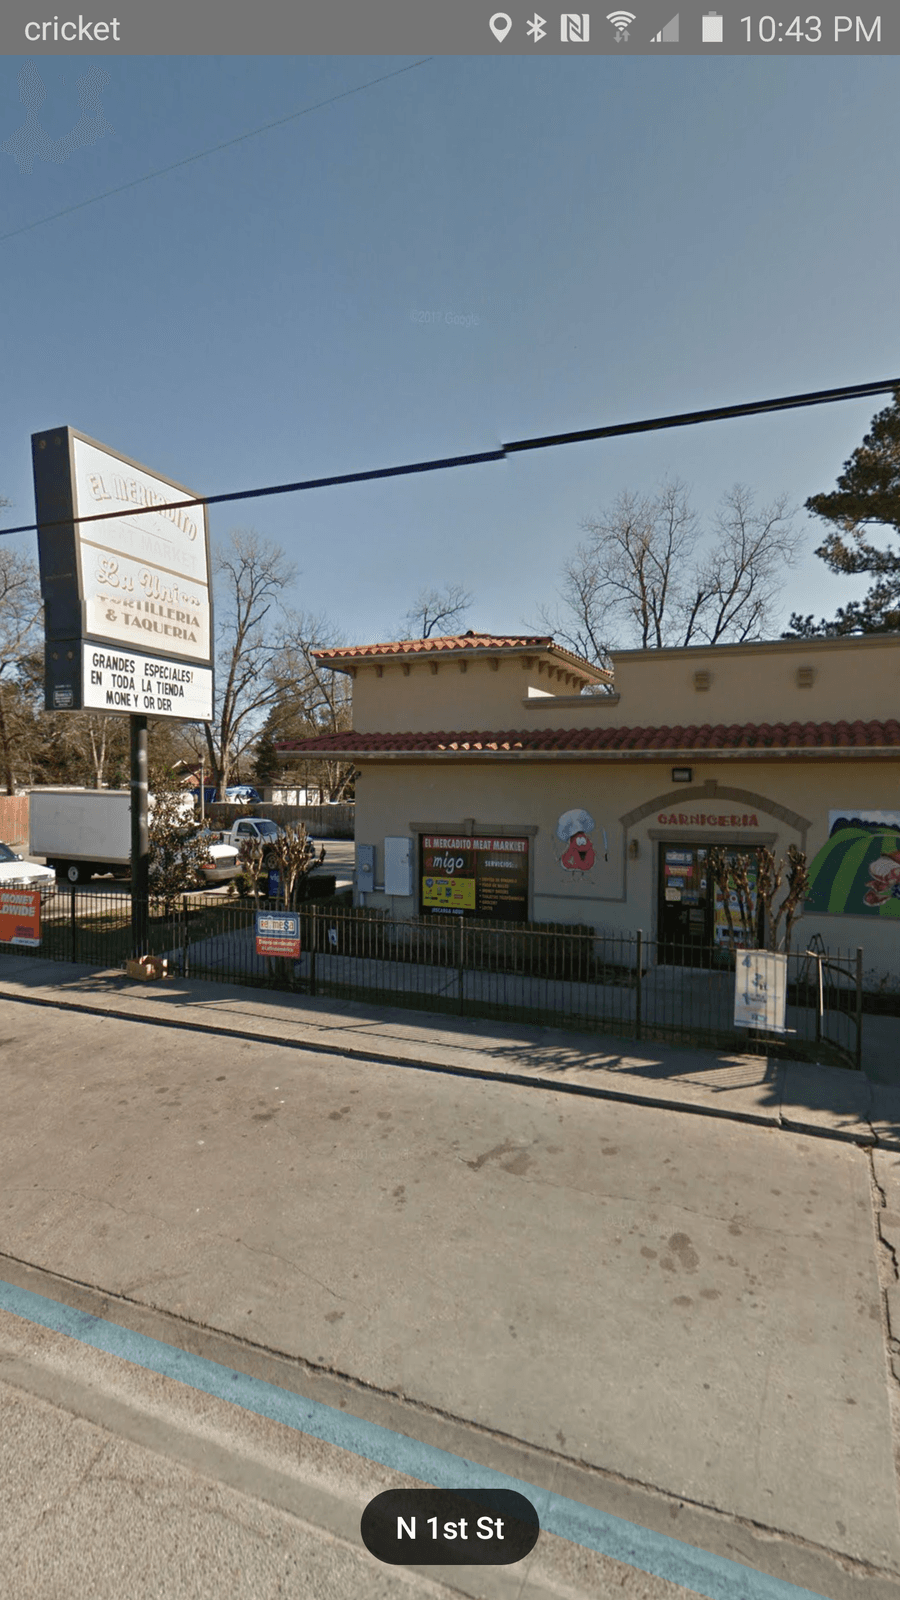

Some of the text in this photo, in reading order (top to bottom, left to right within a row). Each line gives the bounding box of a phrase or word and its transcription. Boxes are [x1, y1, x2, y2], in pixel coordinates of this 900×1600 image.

[87, 473, 112, 501] EL
[95, 554, 133, 592] La
[105, 609, 197, 643] & TAQUERIA
[92, 652, 193, 684] GRANDES ESPECIALES!
[91, 670, 185, 698] EN TODA LA TIENDA
[424, 838, 432, 848] EL
[433, 838, 471, 849] MERCADITO
[473, 839, 491, 850] MEAT
[2, 893, 35, 905] MONEY
